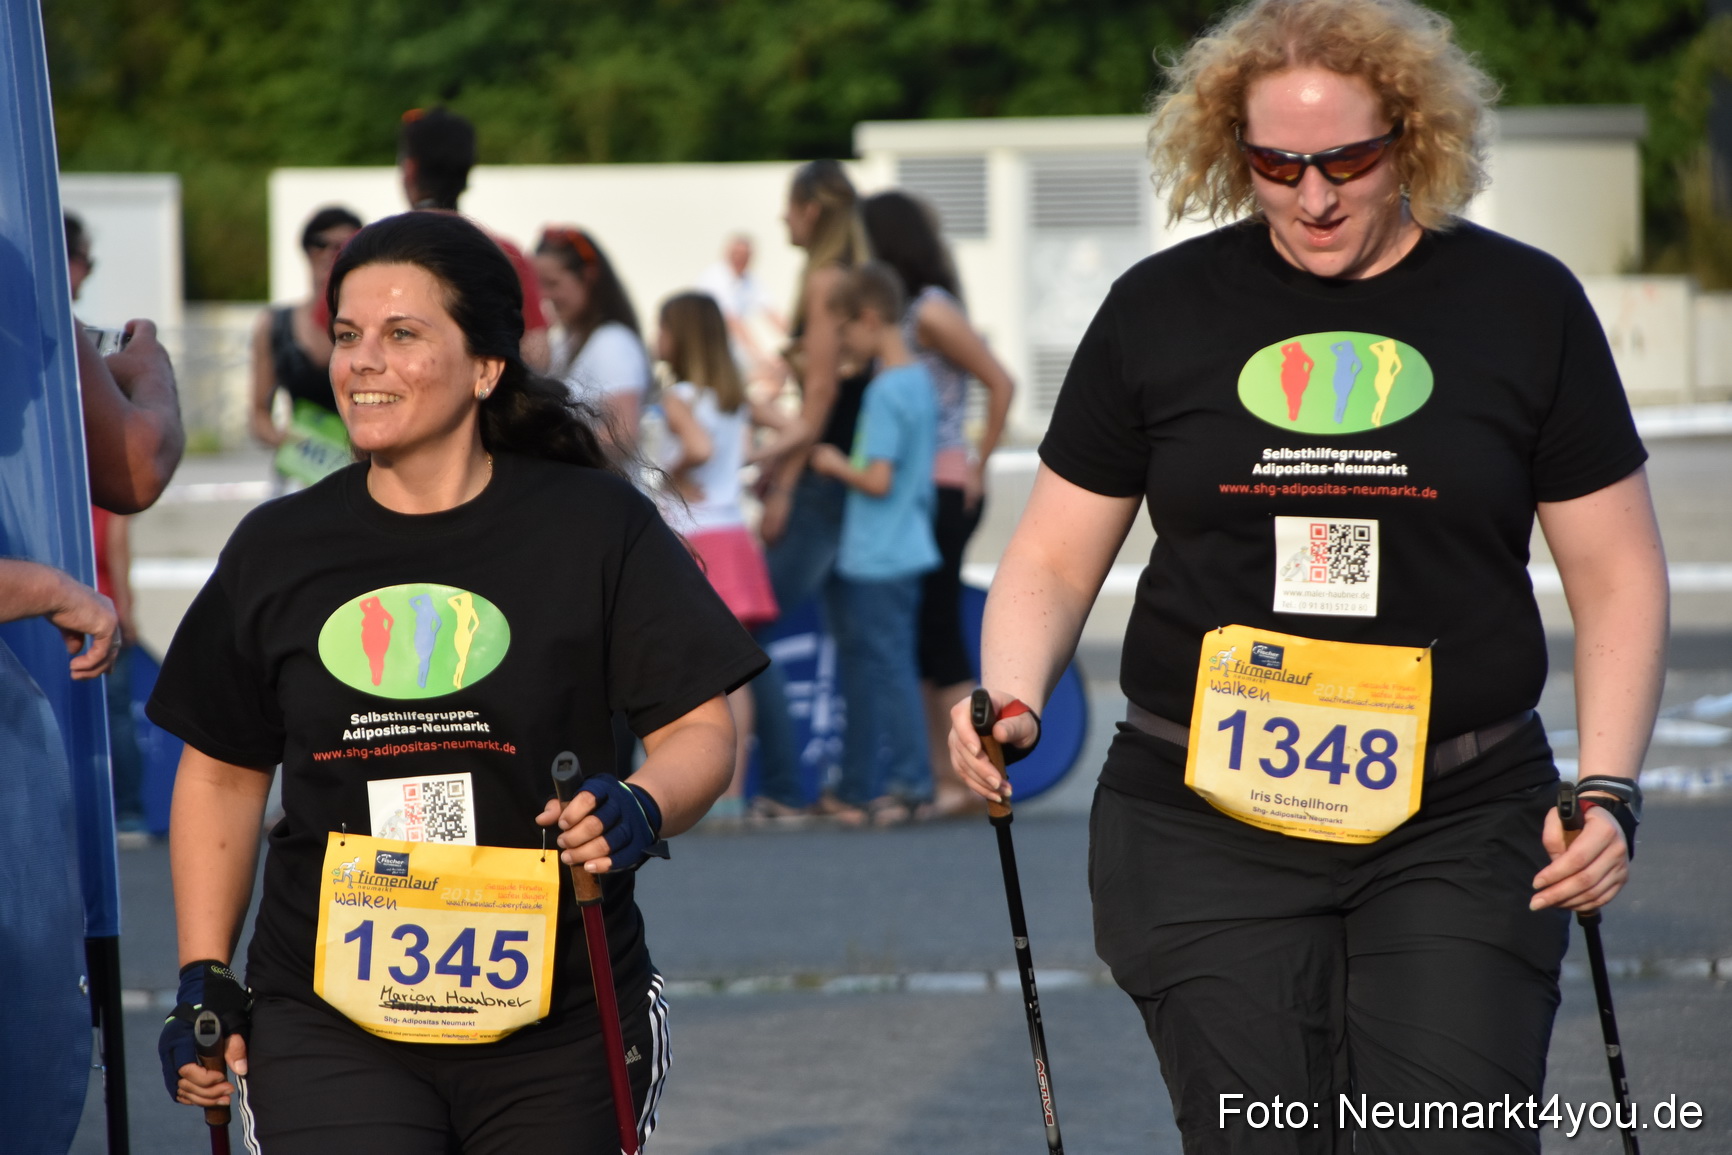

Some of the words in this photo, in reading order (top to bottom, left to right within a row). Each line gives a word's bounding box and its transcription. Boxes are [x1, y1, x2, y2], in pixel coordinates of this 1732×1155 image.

[1262, 448, 1397, 462] Selbsthilfegruppe-
[1252, 462, 1408, 477] Adipositas-Neumarkt
[1219, 482, 1438, 498] www.shg-adipositas-neumarkt.de
[1283, 589, 1370, 599] www.maler-haubner.de
[1335, 603, 1349, 611] 512
[1234, 660, 1313, 686] firmenlauf
[1210, 678, 1271, 702] walken
[1313, 683, 1357, 699] 2015
[350, 709, 479, 725] Selbsthilfegruppe-
[342, 721, 490, 740] Adipositas-Neumarkt
[312, 739, 516, 761] www.shg-adipositas-neumarkt.de
[1217, 709, 1399, 790] 1348
[1250, 789, 1271, 803] Iris
[1274, 793, 1349, 813] Schellhorn
[1253, 806, 1268, 815] Shg-
[1270, 809, 1307, 820] Adipositas
[1309, 815, 1343, 824] Neumarkt
[358, 870, 439, 890] firmenlauf
[334, 891, 397, 911] walken
[440, 887, 483, 901] 2015
[343, 919, 529, 990] 1345
[380, 985, 436, 1002] Marion
[446, 990, 532, 1007] Haubner
[384, 1016, 400, 1024] Shg-
[402, 1017, 439, 1026] Adipositas
[1036, 1059, 1054, 1127] ACTIVE
